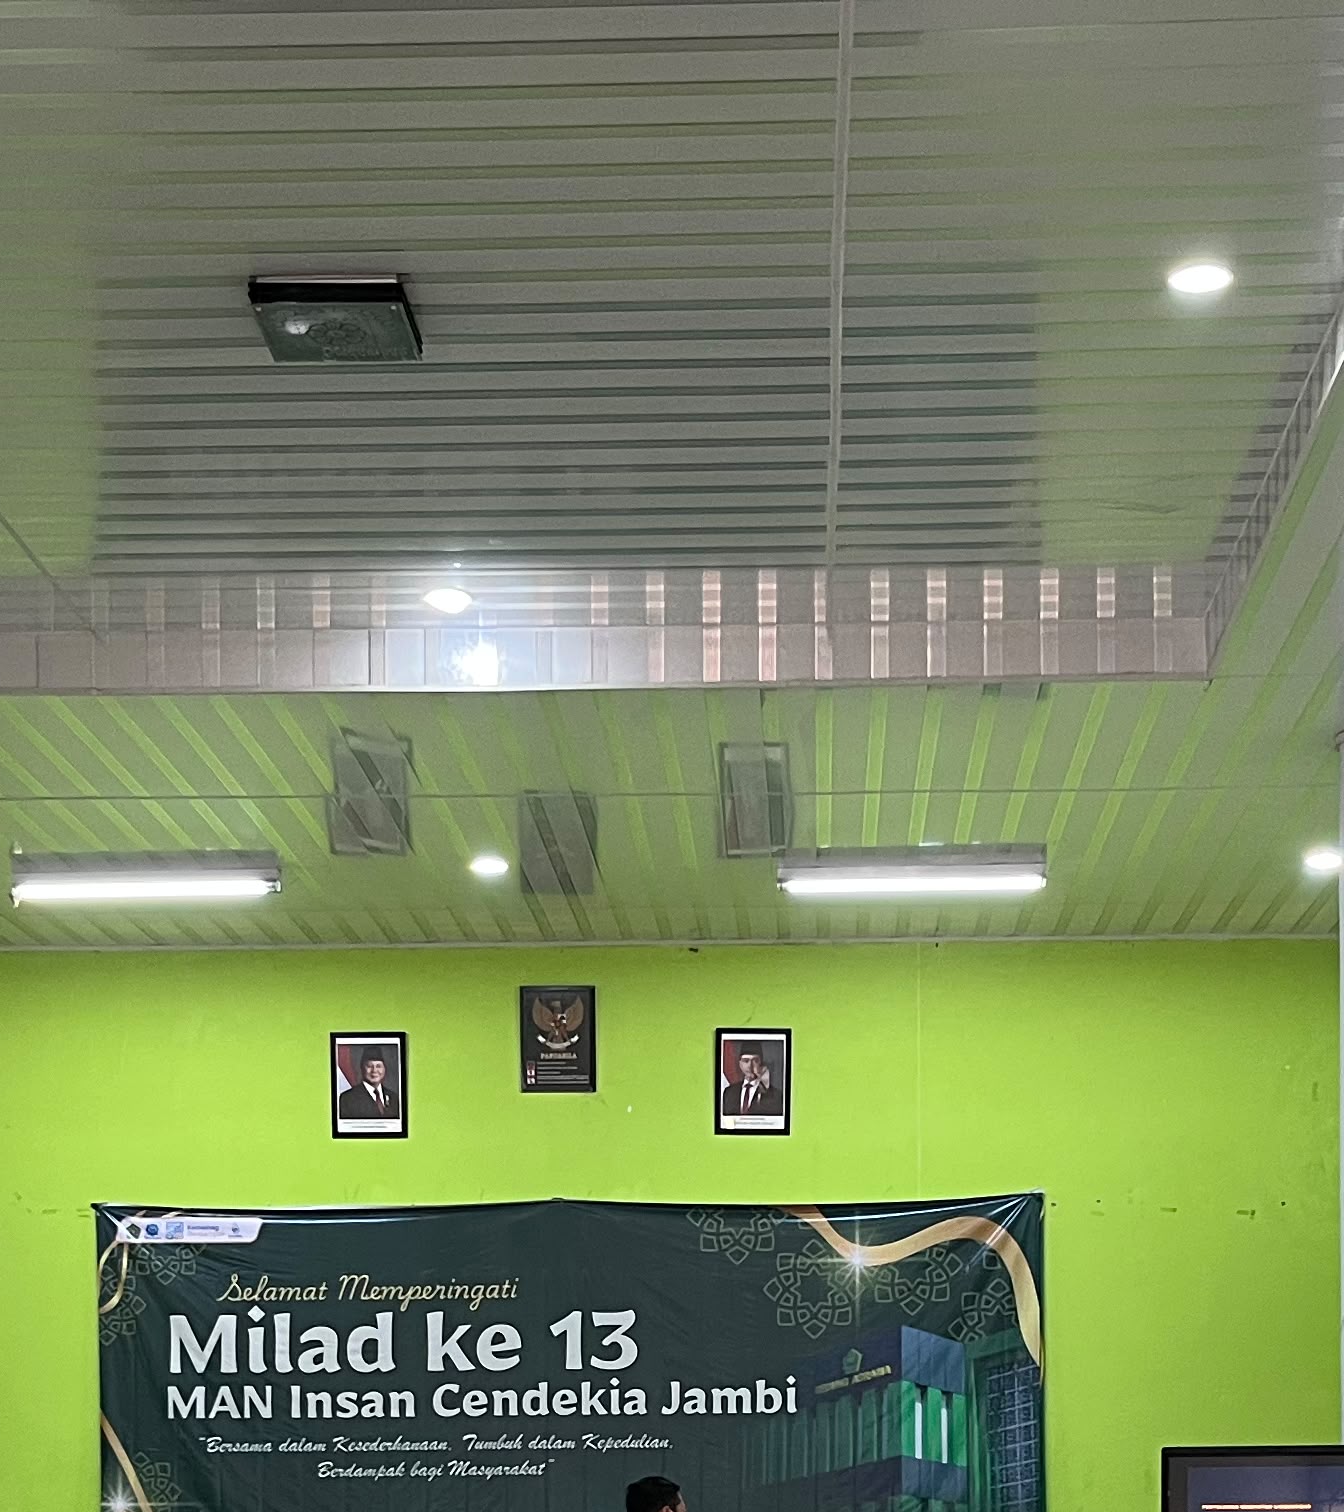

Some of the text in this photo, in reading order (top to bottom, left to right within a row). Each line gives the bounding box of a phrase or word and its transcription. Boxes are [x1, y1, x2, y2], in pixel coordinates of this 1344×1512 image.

[216, 1273, 520, 1312] Selamat Memperingati
[168, 1305, 639, 1374] Milad ke 13
[167, 1385, 273, 1420] MAN
[289, 1384, 416, 1419] Insan
[432, 1377, 648, 1418] Cendekia
[660, 1375, 798, 1416] Jambi
[278, 1437, 328, 1453] dalam
[461, 1433, 523, 1451] Tumbuh
[527, 1434, 576, 1450] dalam
[317, 1460, 406, 1481] Berdampak
[409, 1459, 443, 1482] bagi
